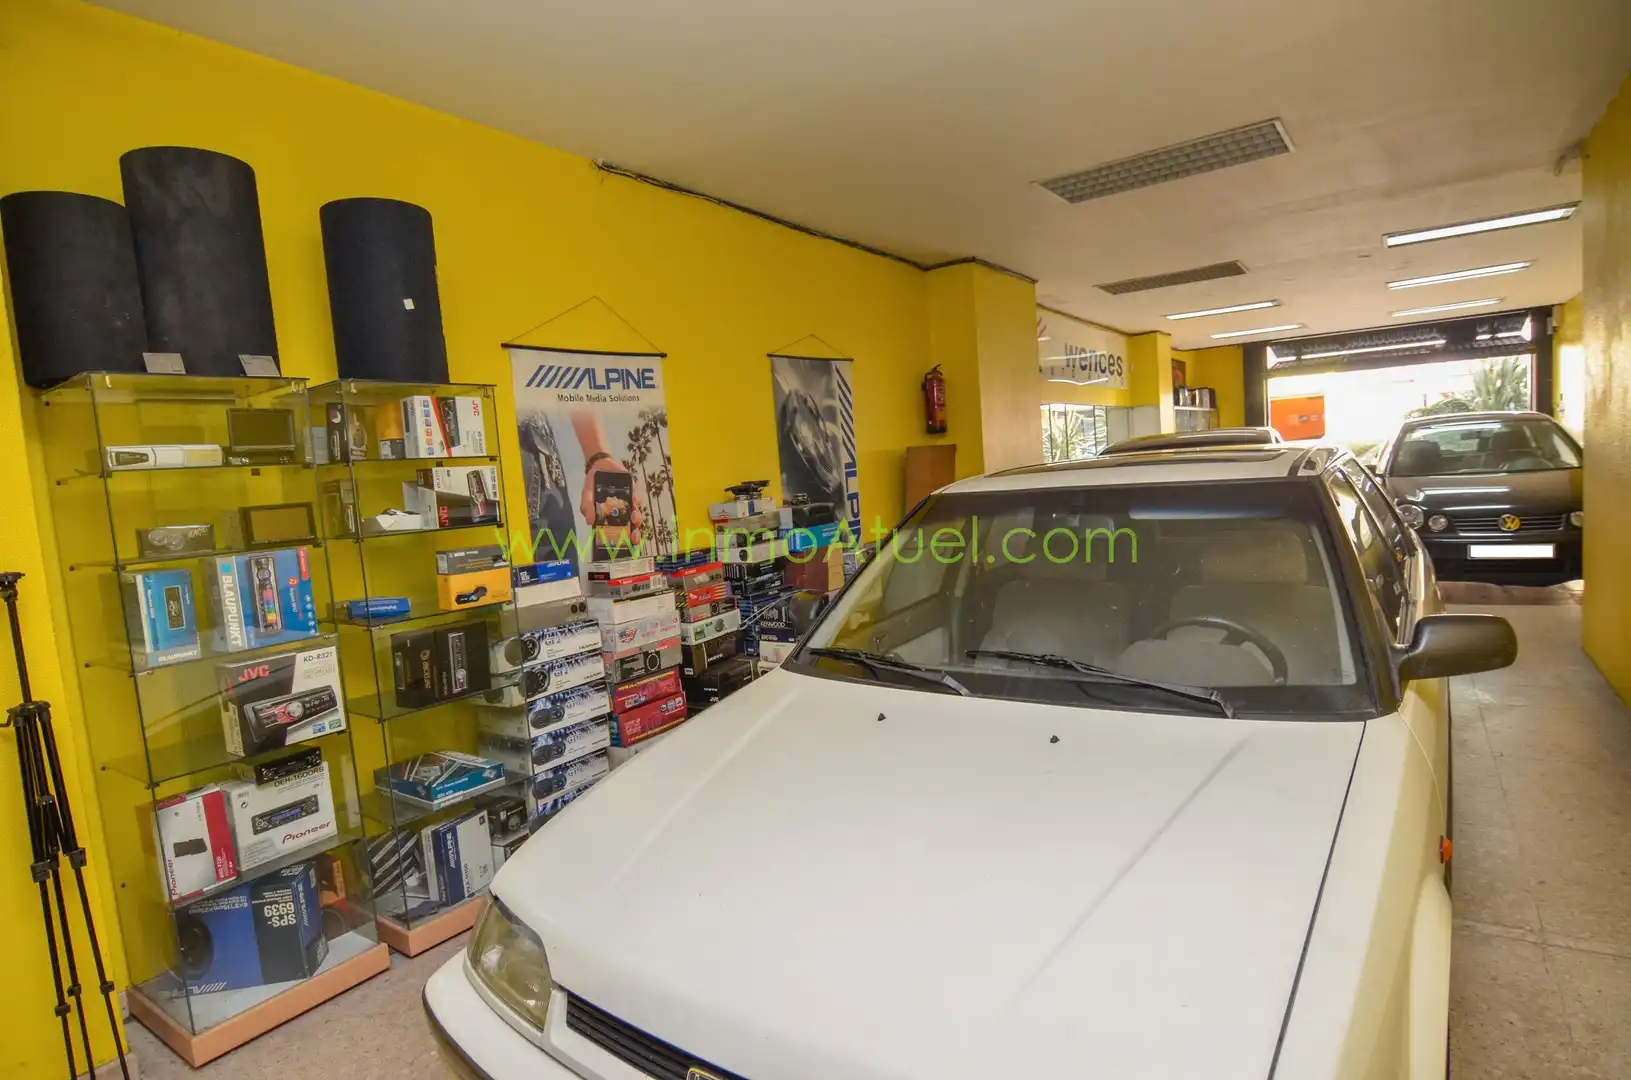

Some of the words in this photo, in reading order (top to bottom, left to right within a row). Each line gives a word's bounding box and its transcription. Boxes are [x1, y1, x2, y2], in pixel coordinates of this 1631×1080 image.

[573, 366, 657, 390] ALPINE
[557, 393, 584, 403] Mobile
[586, 394, 607, 403] Media
[609, 394, 640, 403] Solutions
[472, 400, 480, 416] JVC
[440, 506, 449, 526] JVC
[221, 574, 243, 647] BLAUPUNKT
[303, 651, 334, 664] KD-R321
[238, 664, 271, 682] JVC
[281, 821, 332, 845] Pioneer
[167, 858, 178, 898] Pioneer
[263, 901, 295, 918] 6939
[267, 913, 297, 928] SPS-
